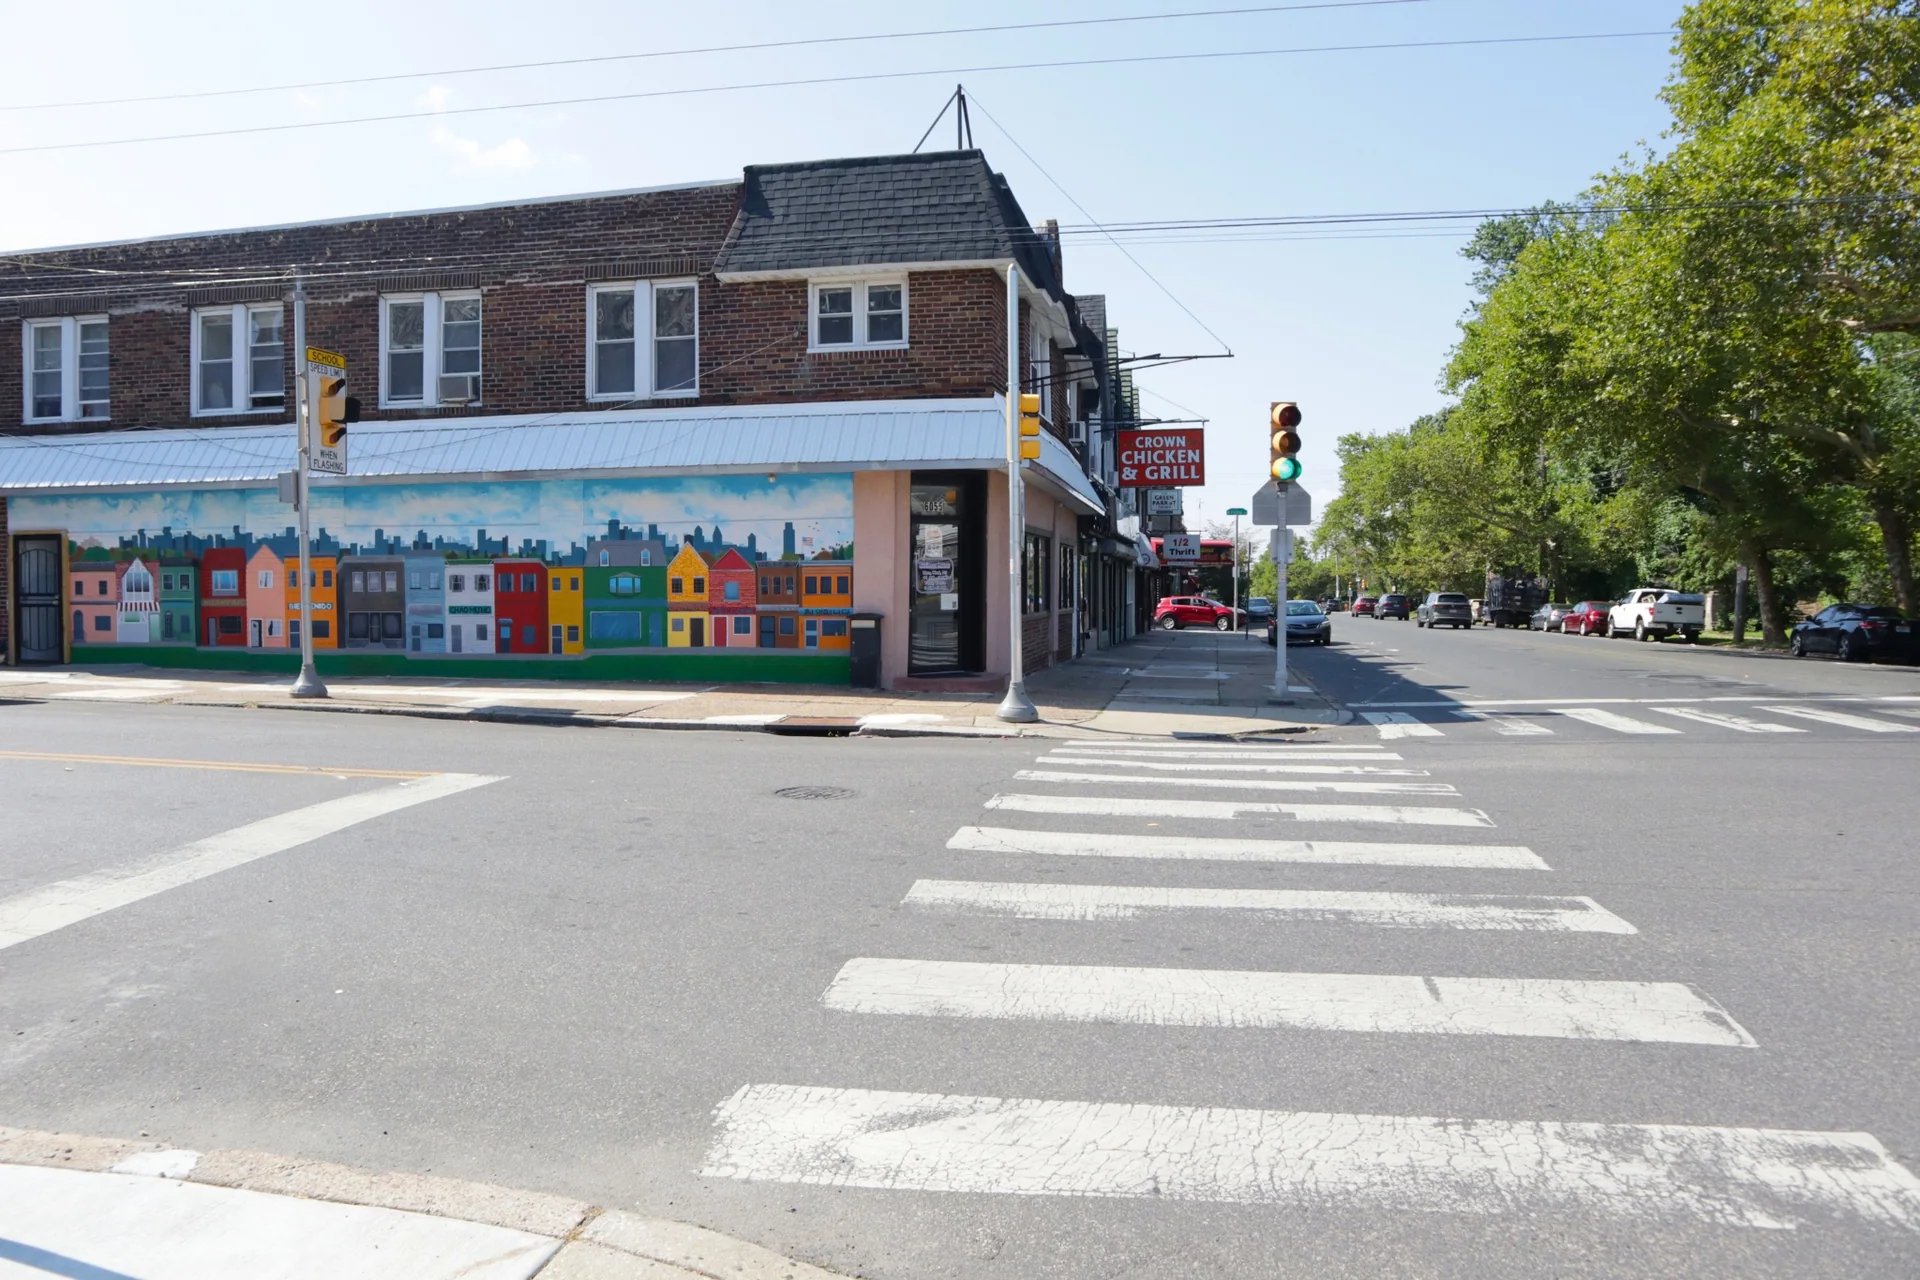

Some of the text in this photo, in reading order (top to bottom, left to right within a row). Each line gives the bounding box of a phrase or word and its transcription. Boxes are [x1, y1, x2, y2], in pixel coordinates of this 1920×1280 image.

[312, 351, 341, 366] SCHOOL
[310, 363, 342, 377] SPEED LIMIT
[1135, 436, 1186, 448] CROWN
[320, 449, 338, 460] WHEN
[1121, 450, 1200, 465] CHICKEN
[313, 459, 344, 471] FLASHING
[1121, 465, 1200, 480] & GRILL
[924, 501, 943, 512] 6055
[1173, 538, 1189, 547] 1/2
[1169, 548, 1196, 556] Thrift
